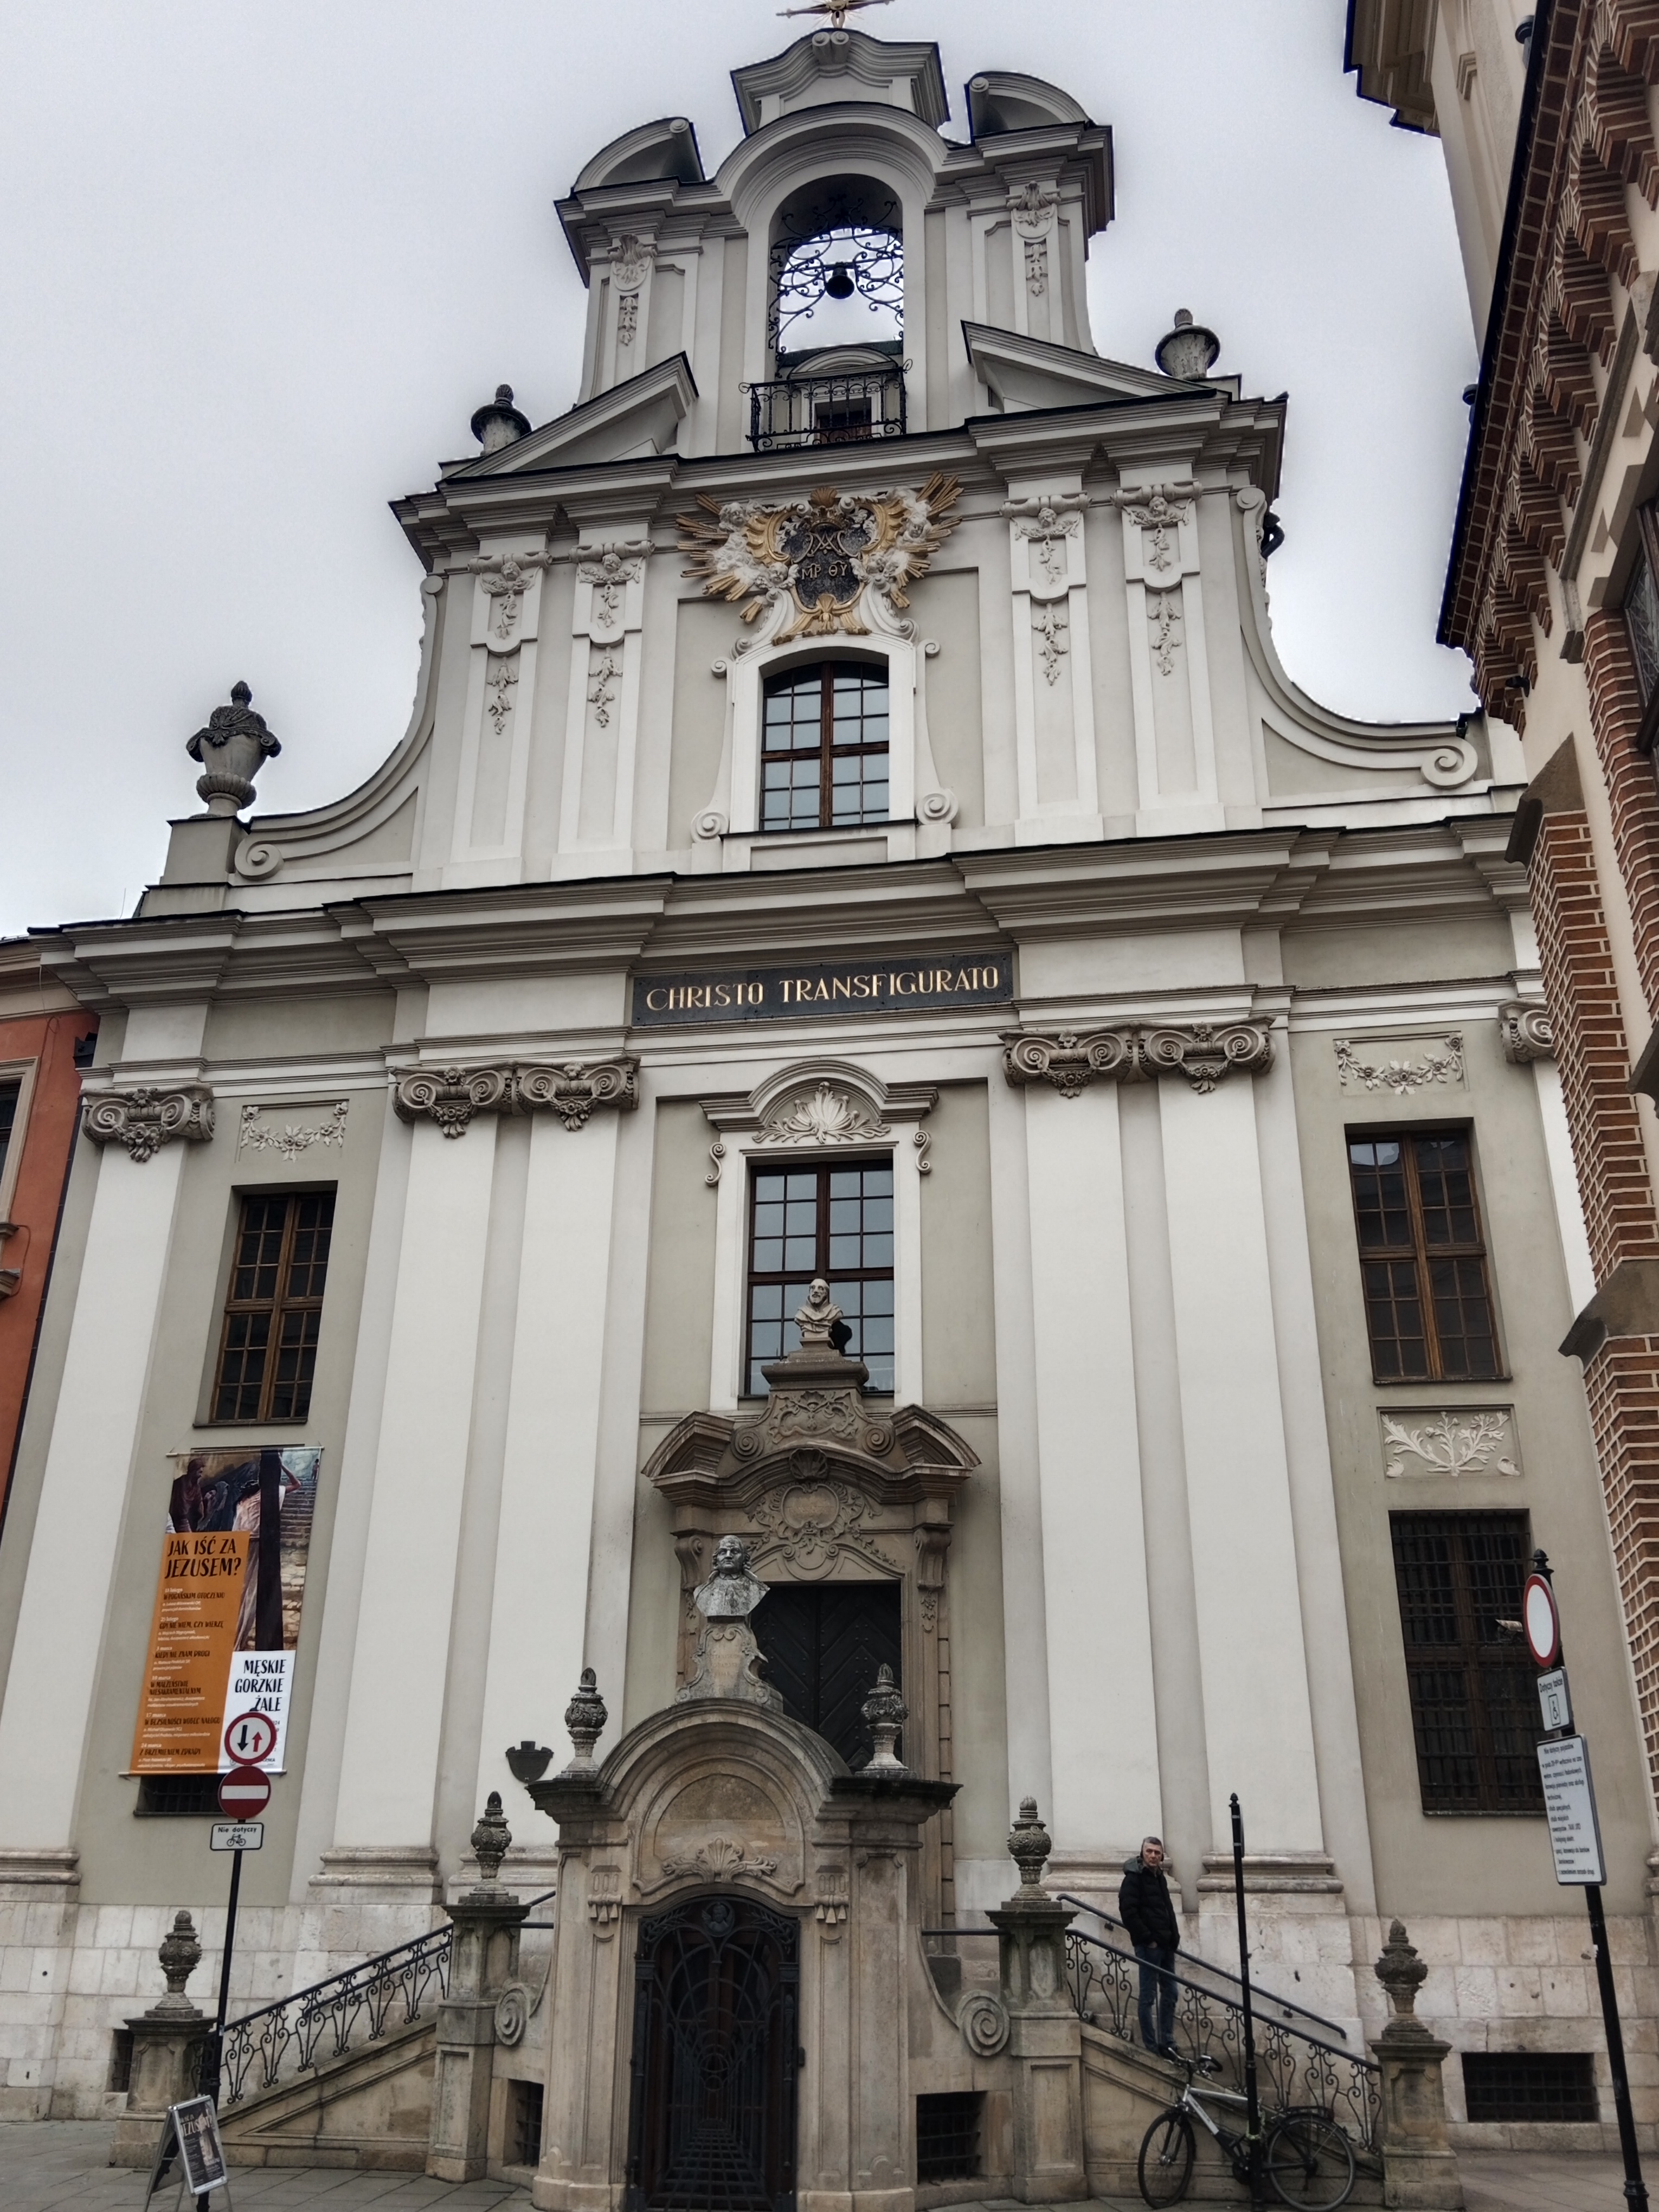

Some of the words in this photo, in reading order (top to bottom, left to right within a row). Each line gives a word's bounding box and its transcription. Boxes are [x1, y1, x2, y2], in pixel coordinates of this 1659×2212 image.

[646, 982, 763, 1011] CHRISTO
[779, 967, 999, 1003] TRANSFIGURATO
[168, 1540, 190, 1557] JAK
[194, 1535, 216, 1555] IŚĆ
[219, 1538, 236, 1554] ZA
[164, 1557, 241, 1579] JEZUSEM?
[243, 1660, 286, 1677] MĘSKIE
[235, 1678, 285, 1693] GORZKIE
[255, 1695, 282, 1712] ŻALE
